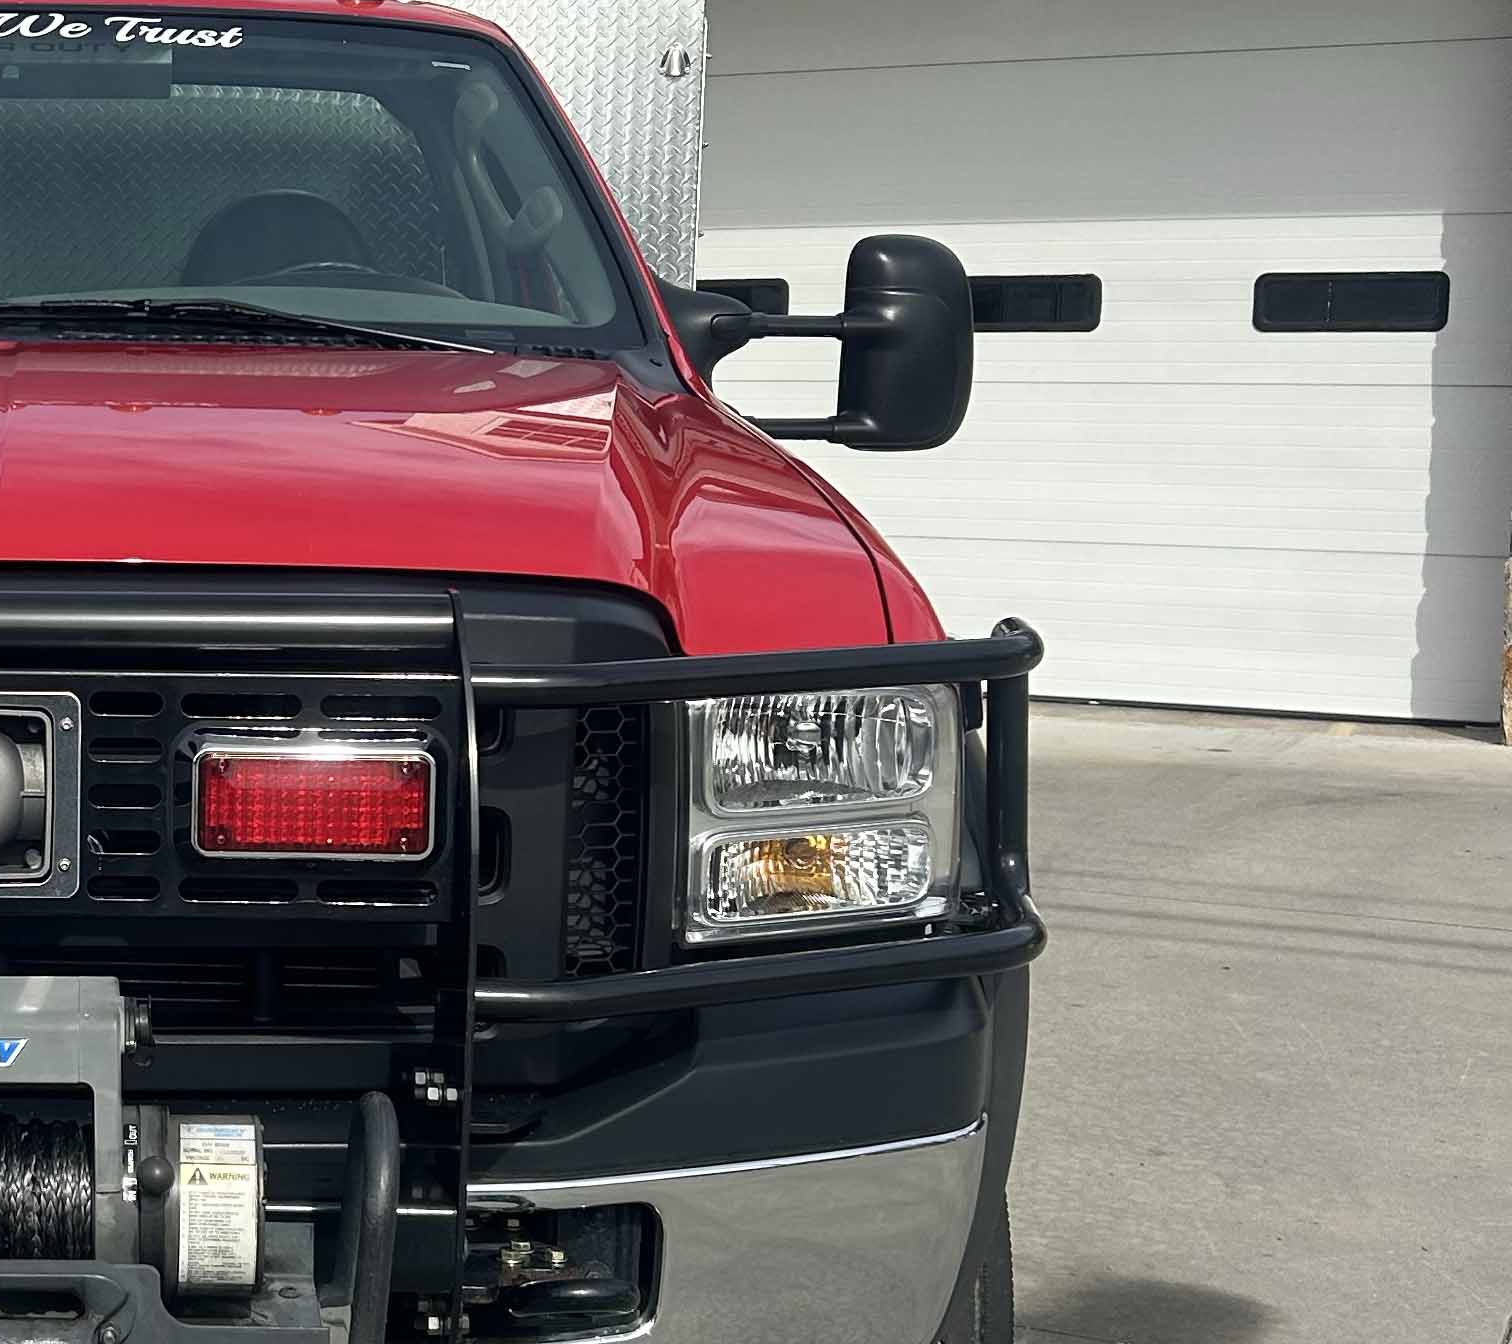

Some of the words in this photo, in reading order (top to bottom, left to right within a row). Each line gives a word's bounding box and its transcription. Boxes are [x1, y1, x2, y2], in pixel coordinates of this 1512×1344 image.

[104, 16, 243, 48] Trust
[29, 41, 131, 54] DUTY
[209, 1172, 251, 1182] WARNING
